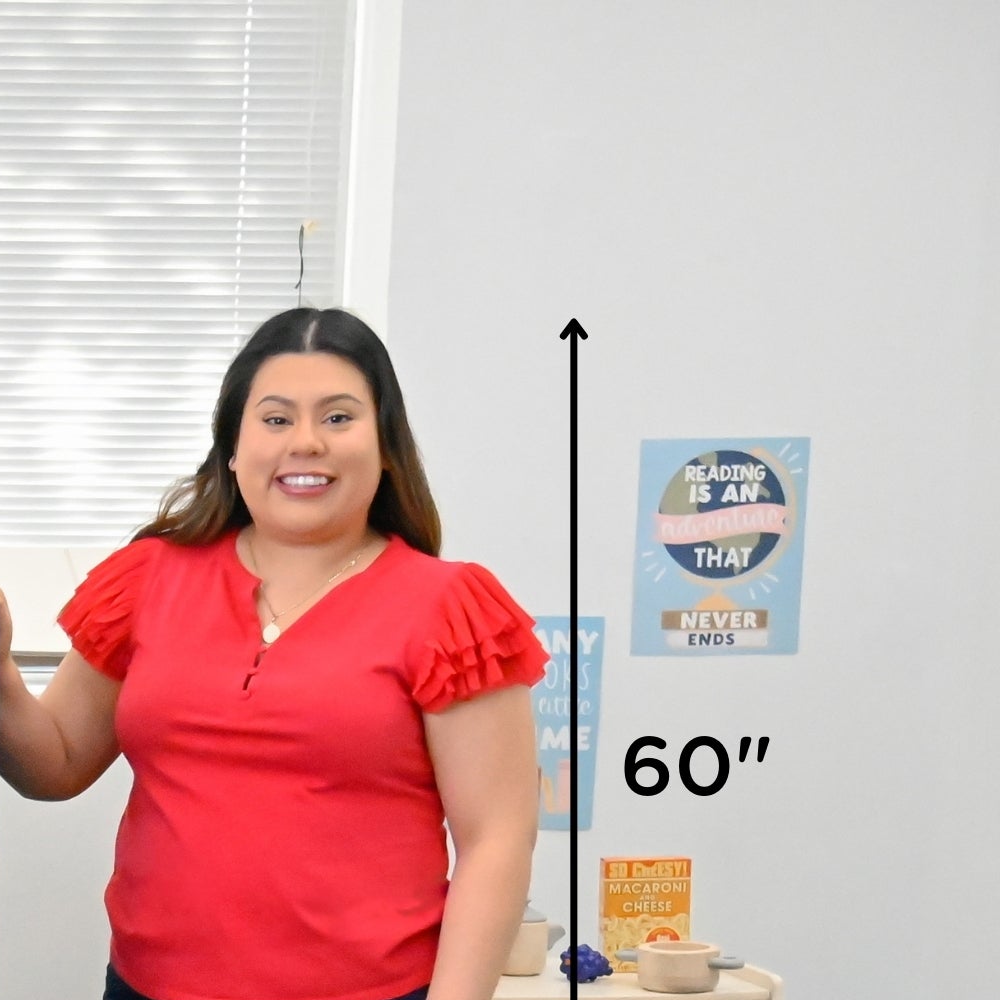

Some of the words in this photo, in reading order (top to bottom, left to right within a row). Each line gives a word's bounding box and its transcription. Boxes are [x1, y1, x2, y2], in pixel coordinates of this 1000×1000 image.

[685, 464, 766, 482] READING
[689, 484, 712, 504] IS
[721, 483, 760, 503] AN
[694, 547, 752, 568] THAT
[680, 611, 757, 629] NEVER
[688, 633, 735, 646] ENDS
[540, 725, 591, 752] ME
[609, 882, 687, 895] MACARONI
[622, 901, 673, 913] CHEESE
